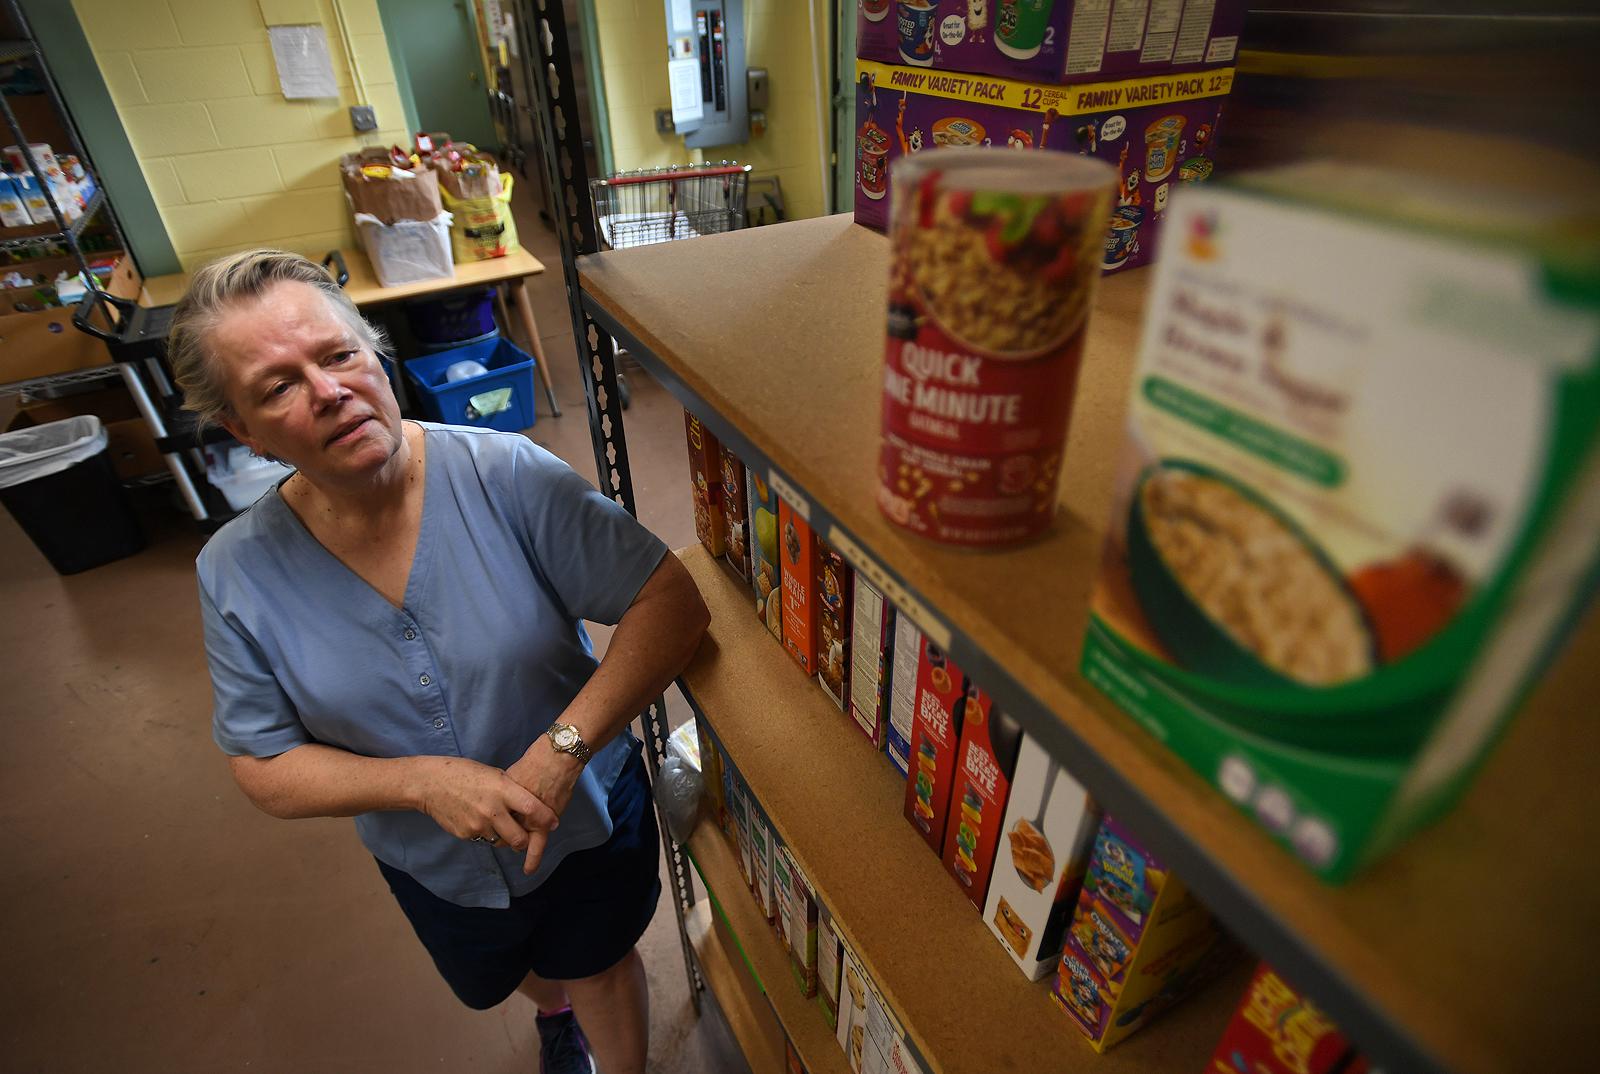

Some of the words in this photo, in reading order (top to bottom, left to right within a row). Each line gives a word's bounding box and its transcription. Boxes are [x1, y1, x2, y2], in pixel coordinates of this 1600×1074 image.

[934, 40, 942, 55] 4
[1045, 27, 1055, 45] 2
[891, 71, 926, 89] FAMILY
[928, 75, 974, 96] VARIETY
[974, 82, 1007, 101] PACK
[1021, 88, 1043, 110] 12
[1042, 98, 1060, 107] CUPS
[1043, 89, 1068, 100] CEREAL
[1077, 88, 1122, 110] FAMILY
[1125, 82, 1174, 103] VARIETY
[1176, 78, 1204, 97] PACK
[1208, 76, 1222, 92] 12
[1179, 140, 1187, 154] 3
[901, 342, 984, 386] QUICK
[914, 381, 1022, 424] MINUTE
[920, 702, 948, 739] BITE
[921, 695, 949, 726] EVERY
[966, 755, 997, 796] BITE
[967, 749, 998, 780] EVERY
[1091, 911, 1132, 957] CRUNCH
[1063, 954, 1099, 992] CRUNCH
